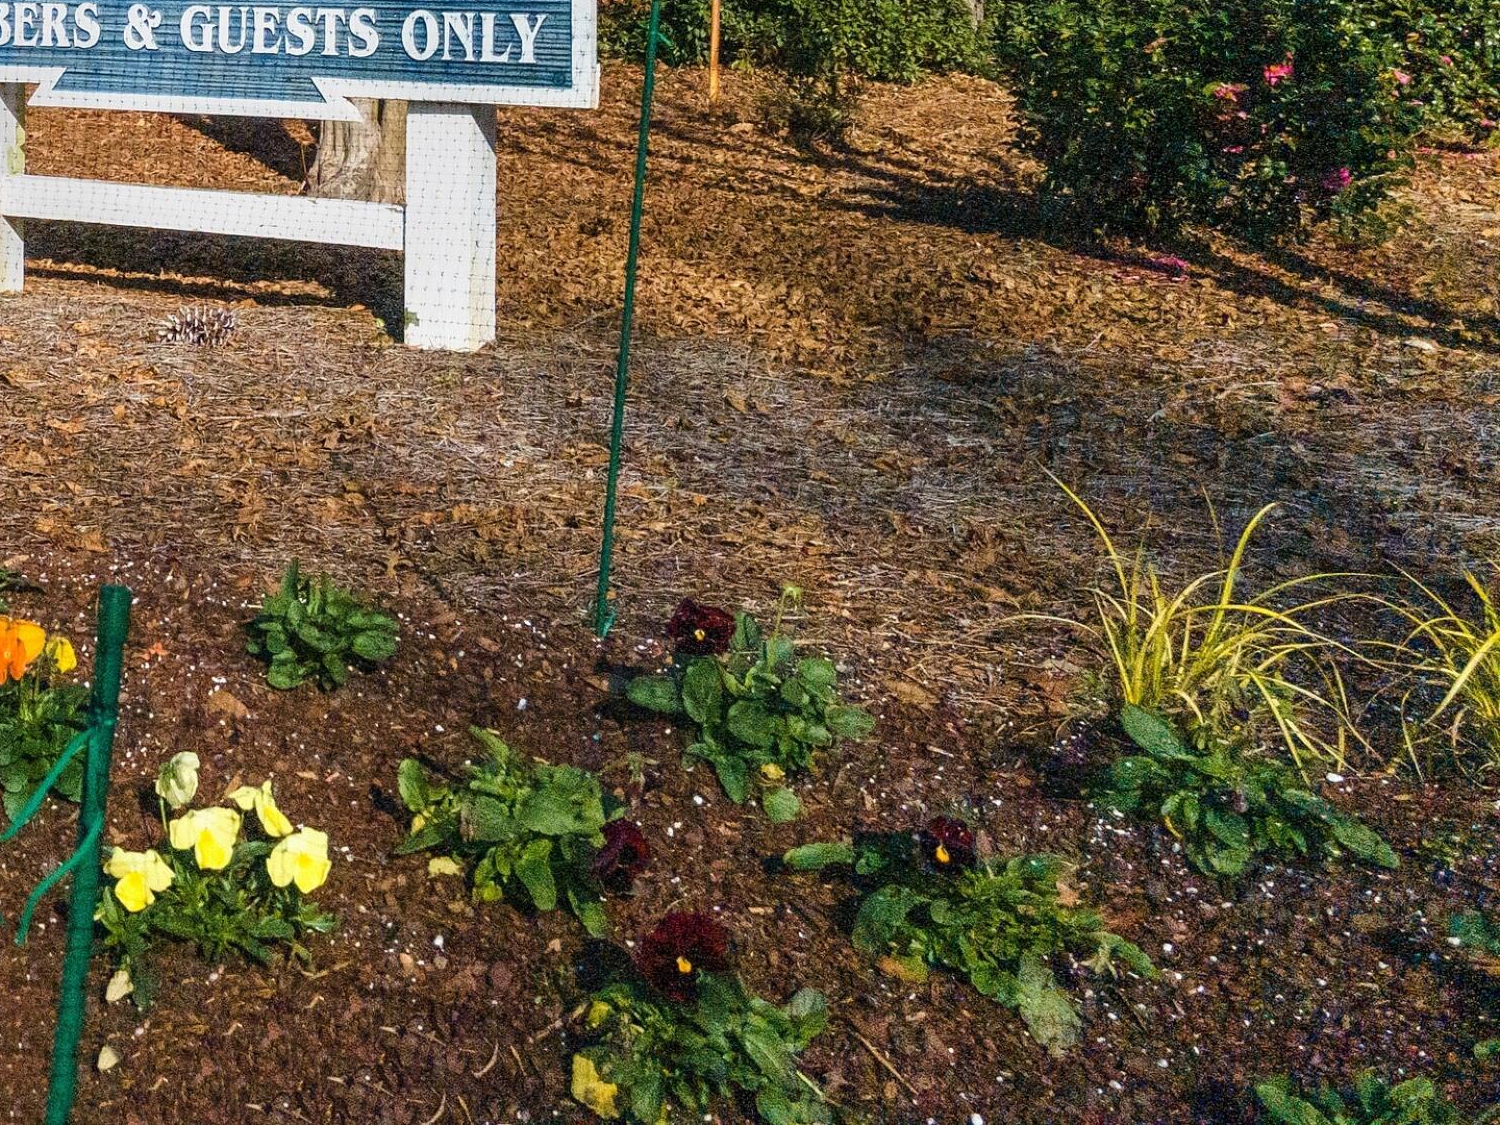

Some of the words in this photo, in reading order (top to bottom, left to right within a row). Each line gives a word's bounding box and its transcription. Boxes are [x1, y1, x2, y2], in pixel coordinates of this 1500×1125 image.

[123, 3, 163, 51] &
[180, 5, 380, 58] GUESTS
[401, 9, 548, 64] ONLY
